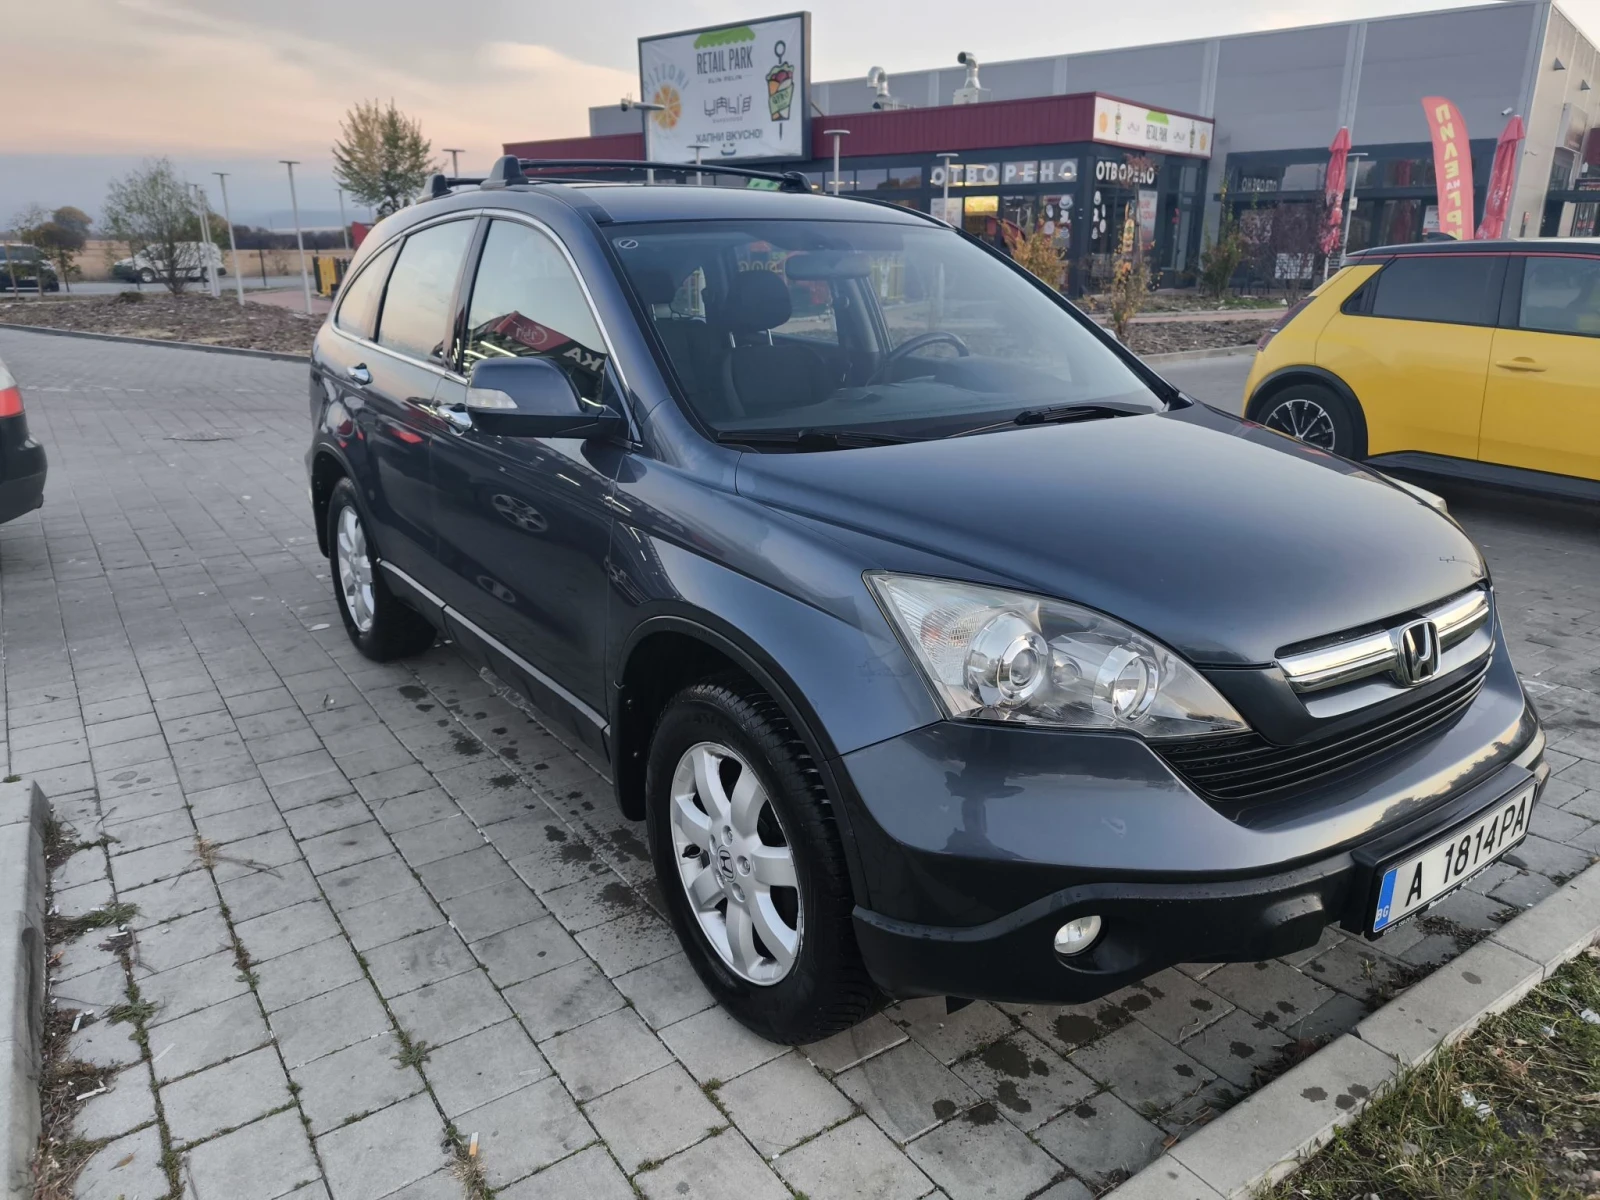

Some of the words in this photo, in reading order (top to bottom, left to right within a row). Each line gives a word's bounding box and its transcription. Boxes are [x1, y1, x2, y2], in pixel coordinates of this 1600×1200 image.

[696, 49, 726, 75] RETAIL
[728, 46, 754, 72] PARK
[695, 132, 725, 144] ХАПНИ
[931, 160, 1077, 186] ОТВОРЕНО
[1095, 160, 1155, 185] ОТВОРЕНО
[1405, 861, 1423, 907] A
[1376, 904, 1390, 921] BG
